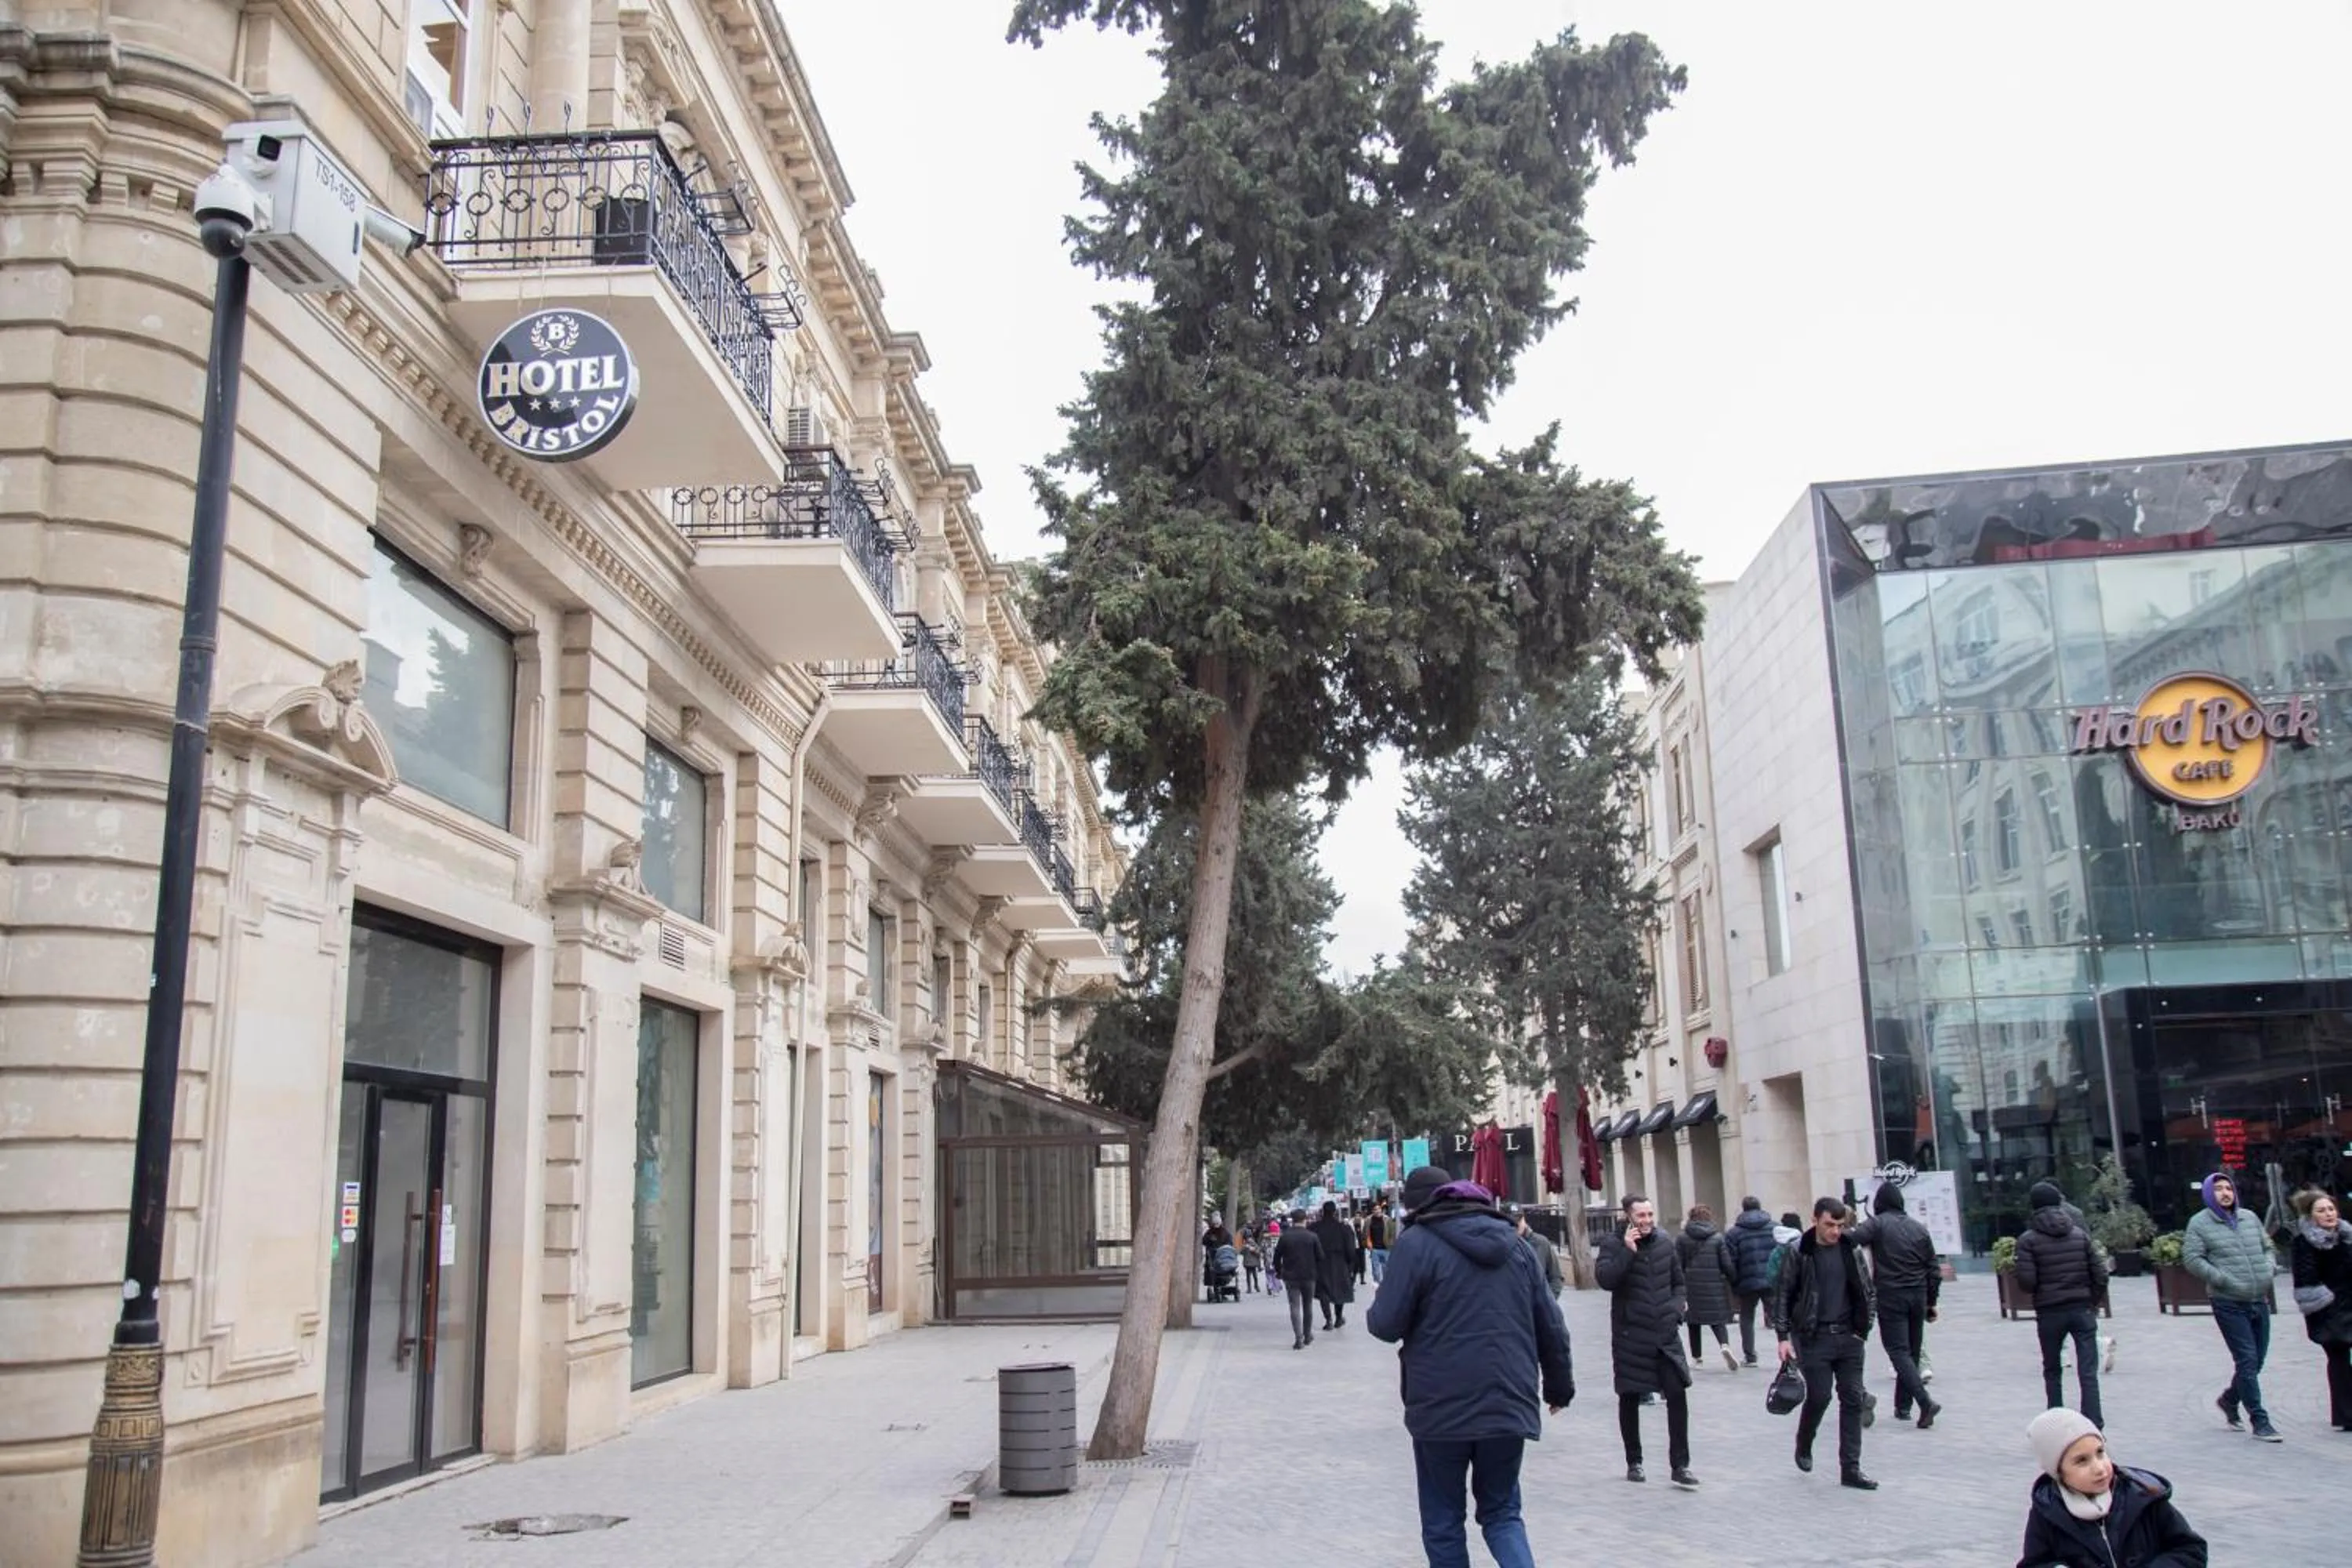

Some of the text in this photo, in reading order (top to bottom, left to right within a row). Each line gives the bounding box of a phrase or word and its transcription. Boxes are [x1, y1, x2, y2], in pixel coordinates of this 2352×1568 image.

[547, 323, 565, 340] B
[487, 354, 625, 398] HOTEL
[489, 395, 620, 450] BRISTOL
[2072, 695, 2320, 750] Hard Rock
[2173, 758, 2233, 780] CAFE
[2179, 812, 2241, 830] BAKU
[1455, 1133, 1521, 1152] PL
